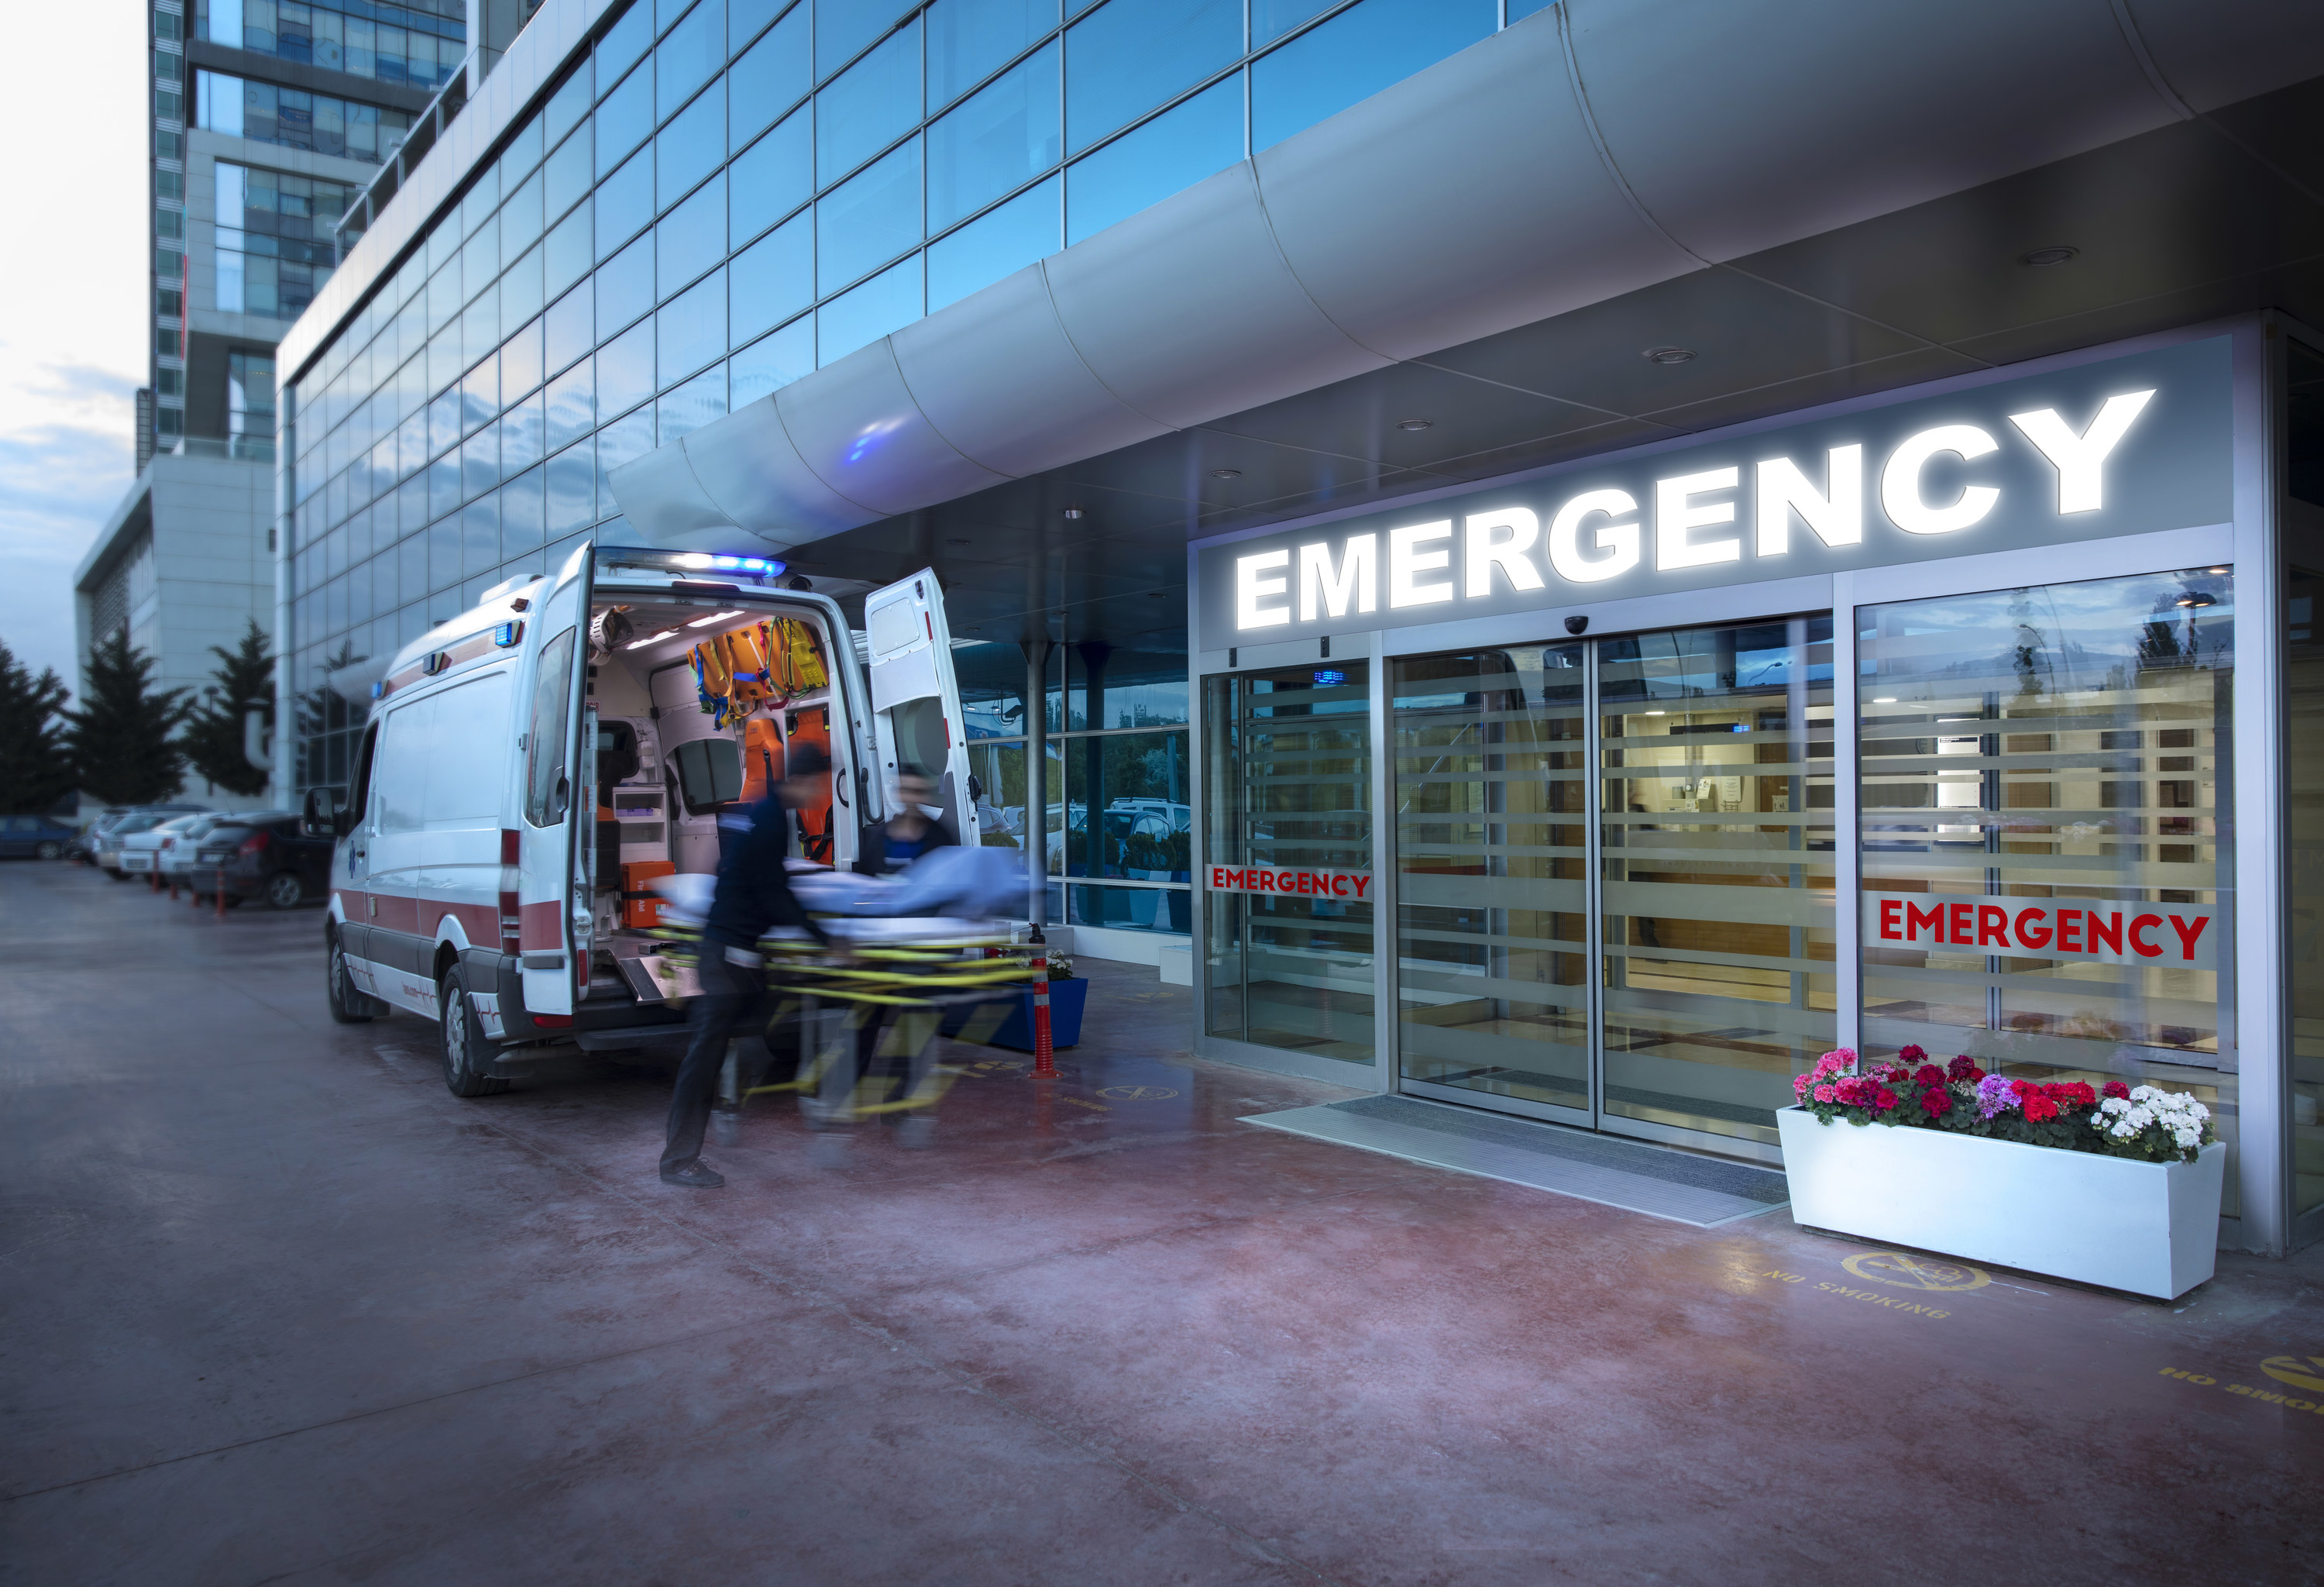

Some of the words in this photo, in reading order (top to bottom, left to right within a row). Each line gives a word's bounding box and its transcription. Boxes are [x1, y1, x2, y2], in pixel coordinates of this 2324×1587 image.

[1237, 389, 2156, 630] EMERGENCY
[1213, 867, 1370, 897] EMERGENCY
[1880, 900, 2211, 962] EMERGENCY
[1762, 1270, 1807, 1282] NO
[1812, 1282, 1951, 1318] SMOKING
[2157, 1367, 2216, 1385] NO
